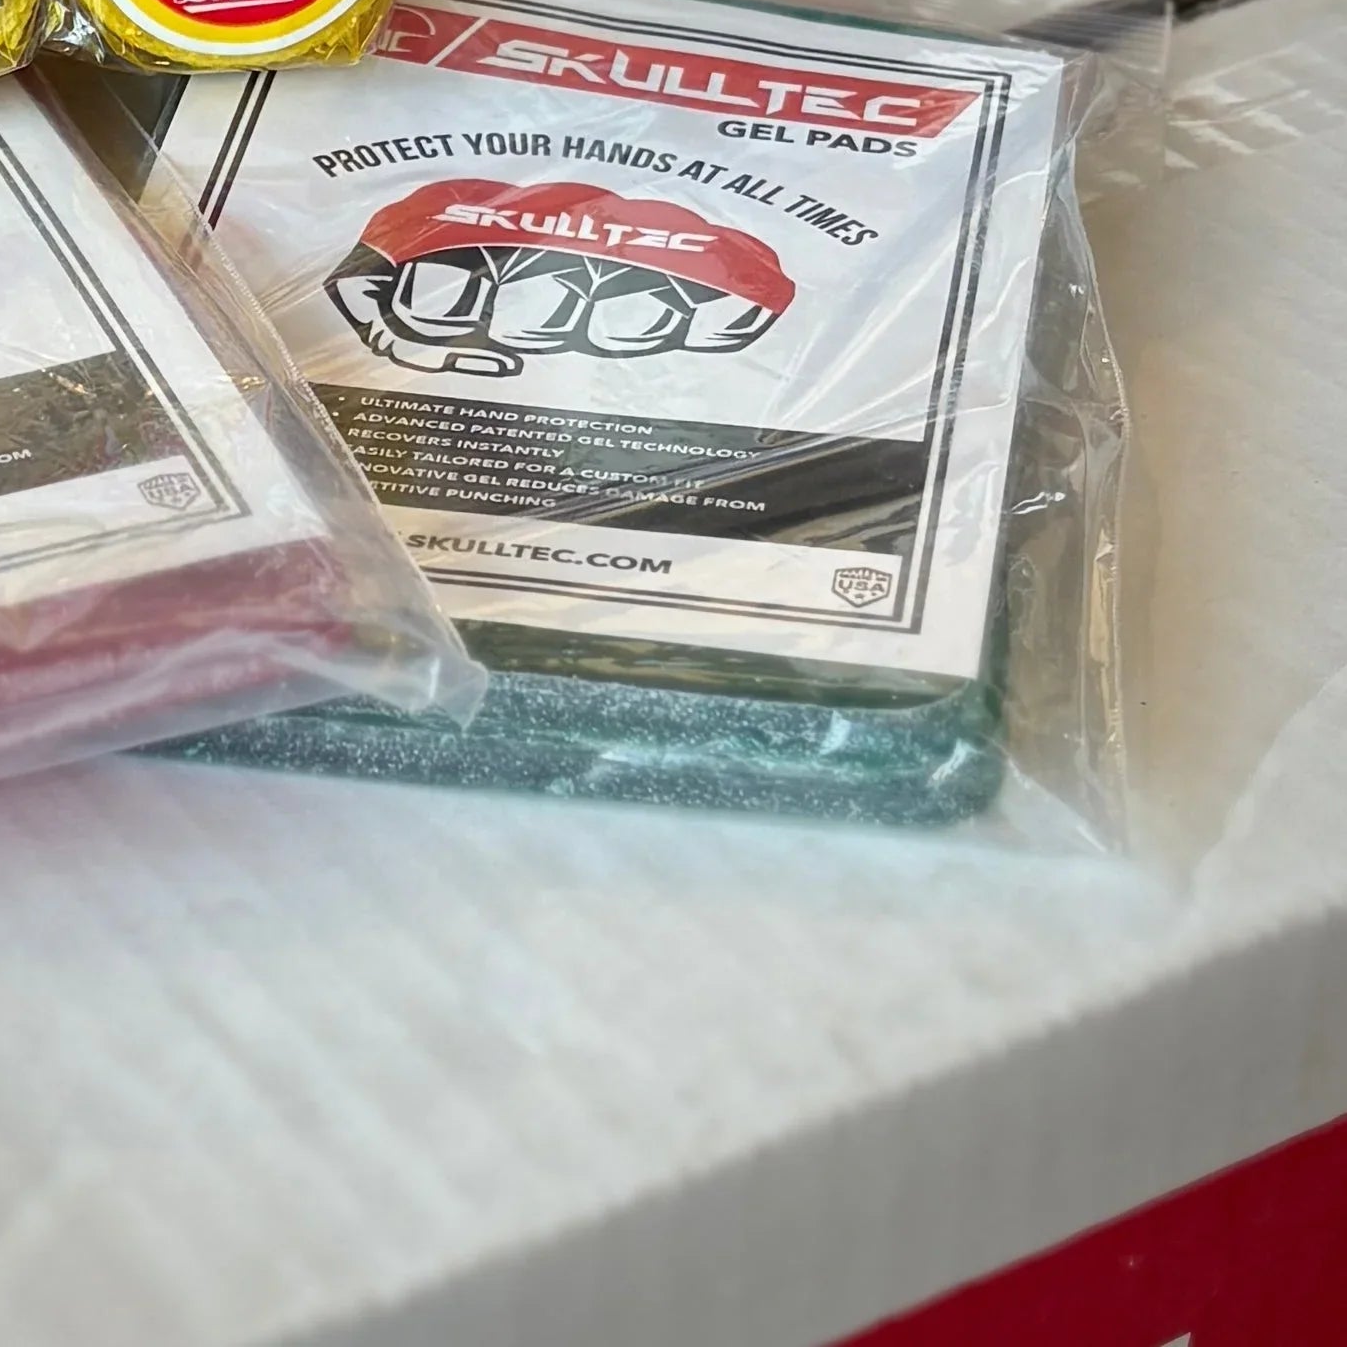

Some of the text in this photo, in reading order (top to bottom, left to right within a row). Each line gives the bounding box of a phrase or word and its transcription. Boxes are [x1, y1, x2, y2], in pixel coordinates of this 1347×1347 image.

[476, 38, 922, 127] SKULLTEC
[717, 120, 919, 158] GEL PADS
[312, 132, 879, 247] PROTECT YOUR HANDS AT ALL TIMES
[433, 203, 719, 252] SKULLTEC
[360, 396, 653, 435] ULTIMATE HAND PROTECTION
[347, 427, 565, 458] RECOVERS INSTANTLY
[353, 412, 762, 460] ADVANCED PATENTED GEL TECHNOLOGY
[412, 450, 510, 470] TAILORED
[513, 461, 557, 475] FOR
[558, 465, 576, 477] A
[445, 488, 558, 509] PUNCHING
[462, 472, 502, 487] GEL
[505, 477, 601, 497] REDUCES
[702, 496, 767, 513] FROM
